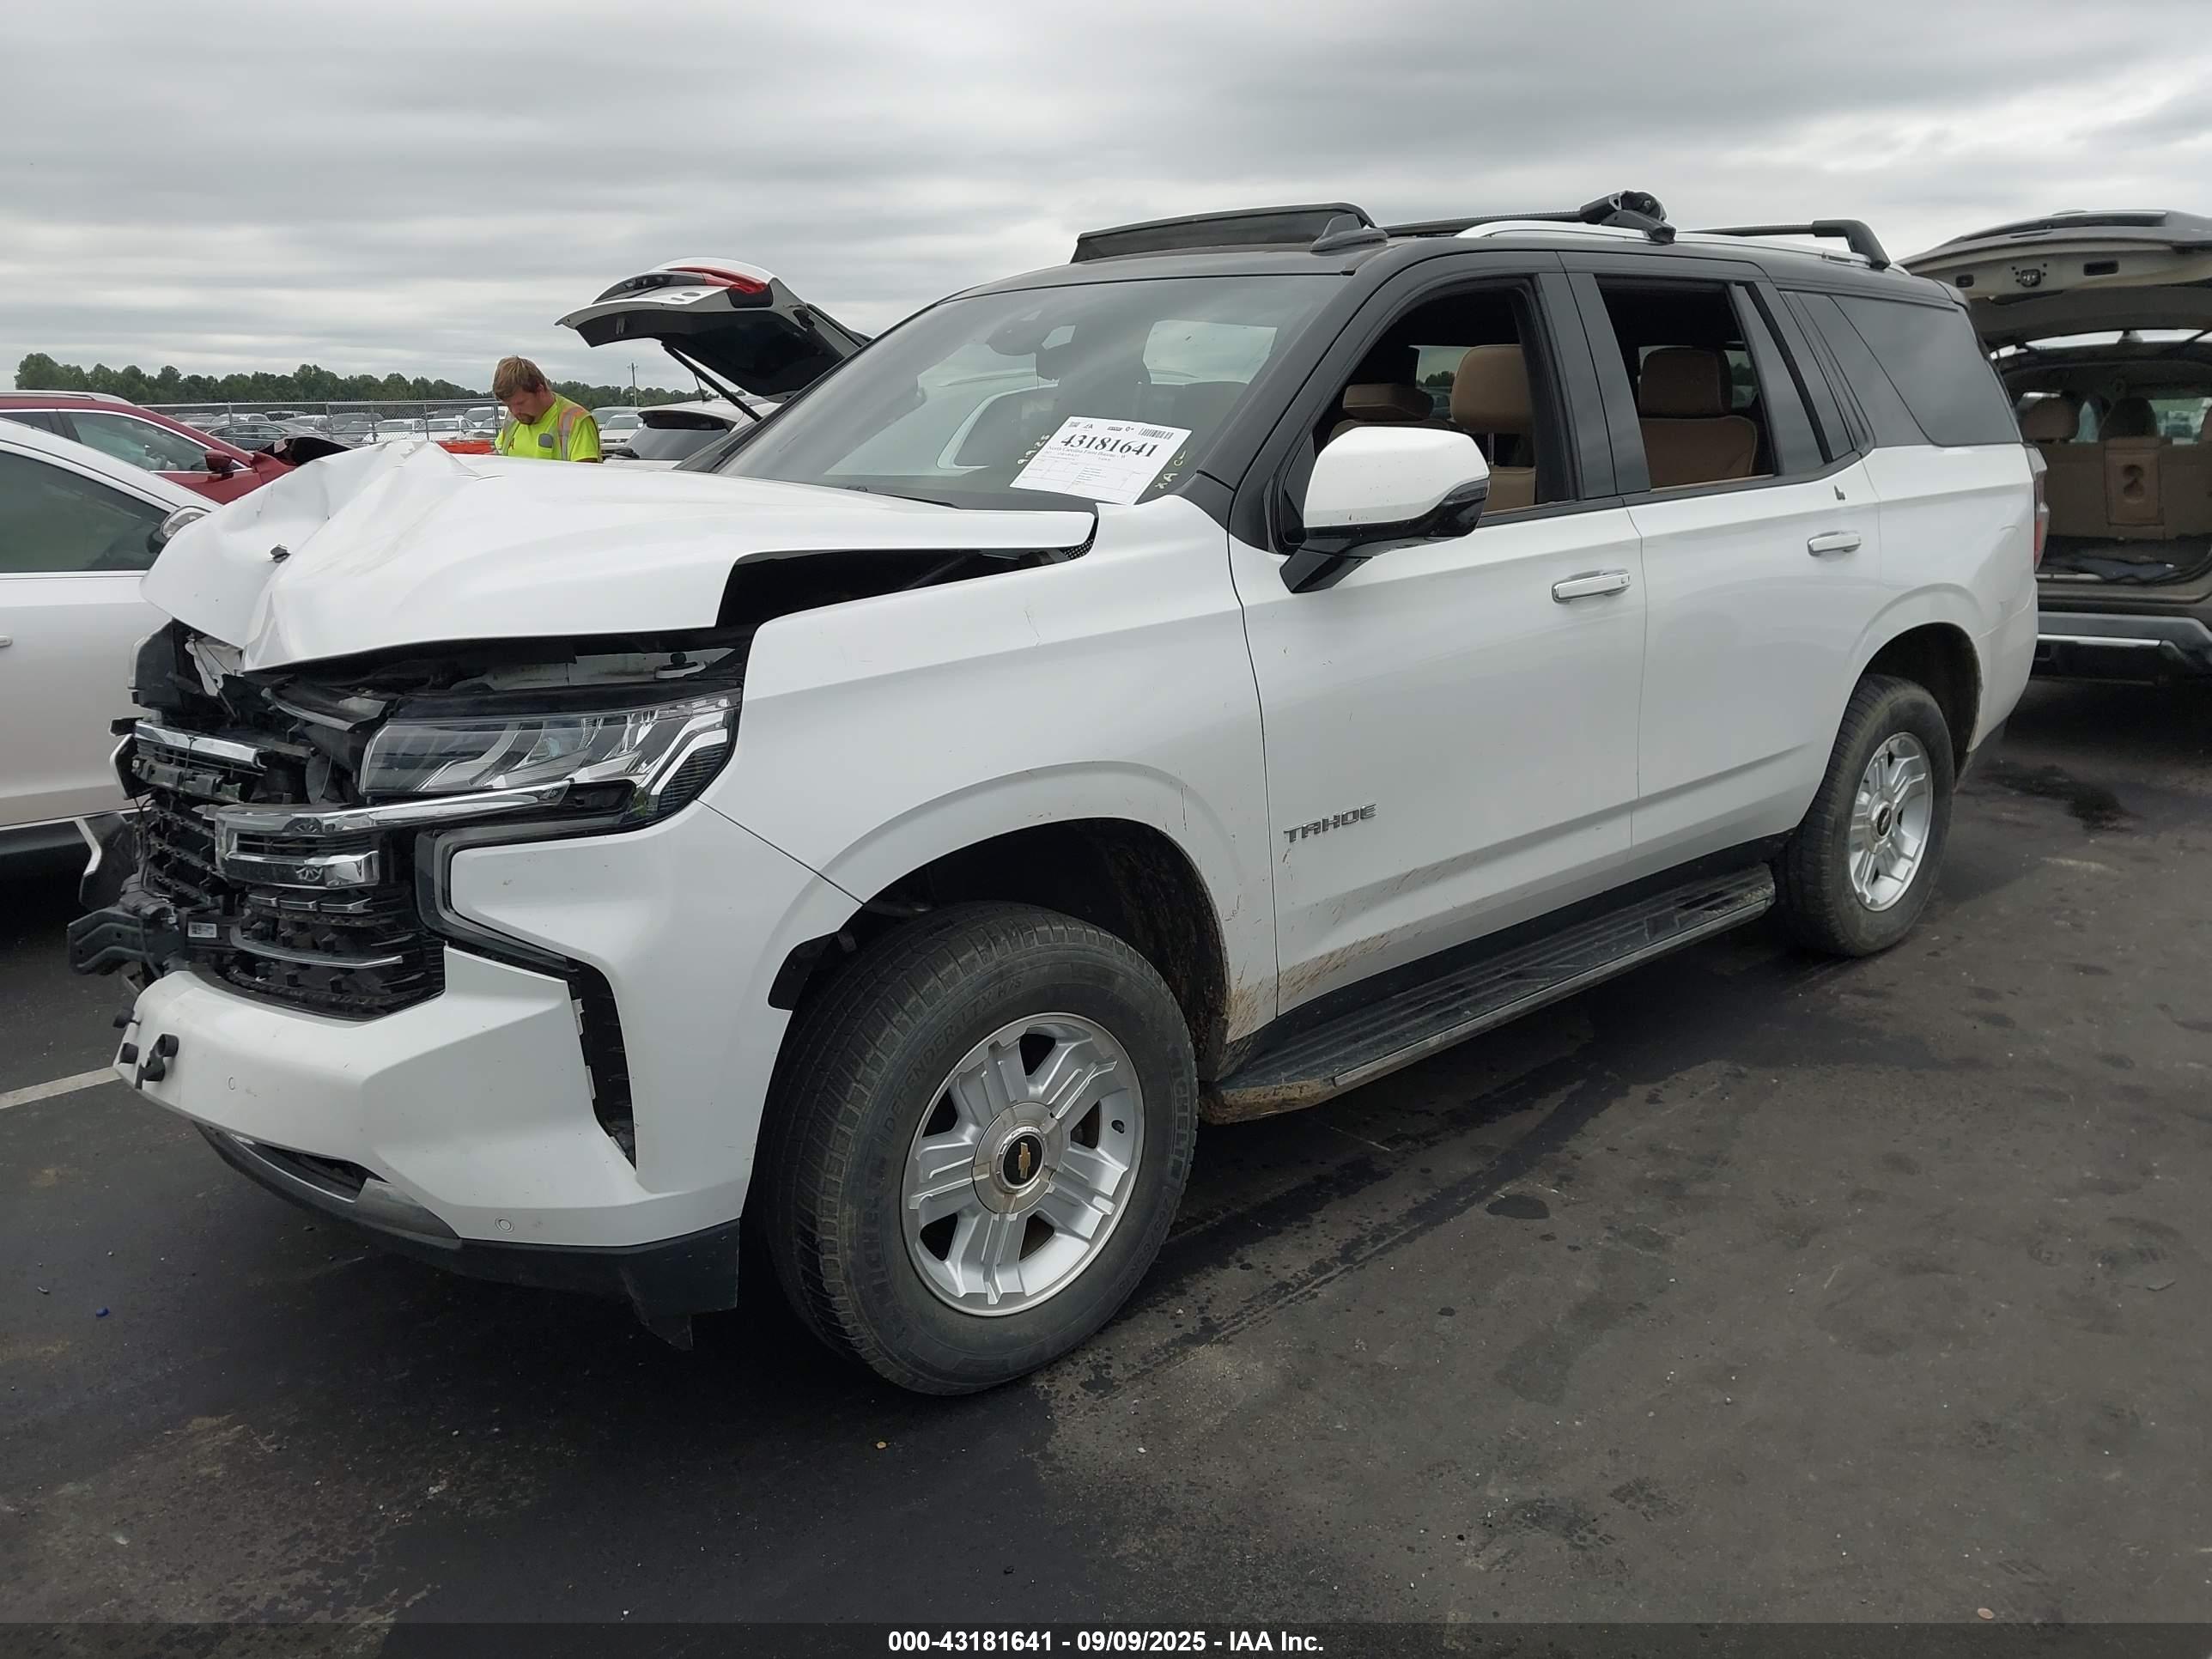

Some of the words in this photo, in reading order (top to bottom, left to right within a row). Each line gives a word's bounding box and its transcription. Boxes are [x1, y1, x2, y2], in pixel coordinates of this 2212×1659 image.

[1060, 434, 1159, 458] 43181641
[1284, 804, 1377, 843] TAHOE
[882, 1021, 957, 1133] DEFENDER
